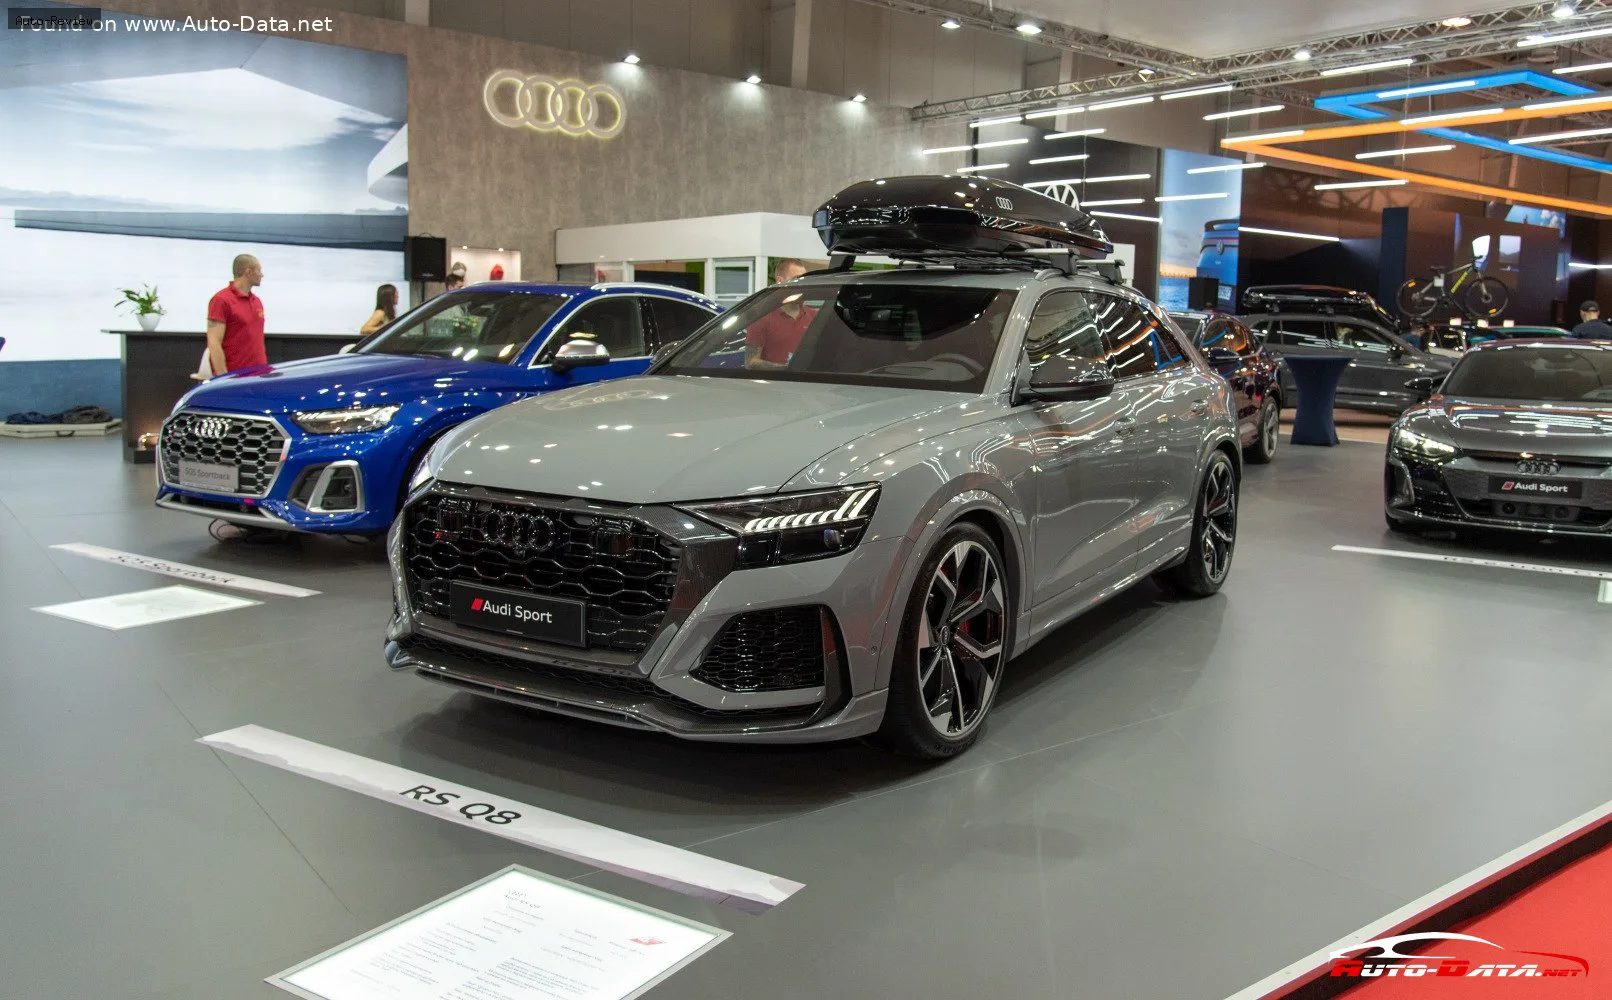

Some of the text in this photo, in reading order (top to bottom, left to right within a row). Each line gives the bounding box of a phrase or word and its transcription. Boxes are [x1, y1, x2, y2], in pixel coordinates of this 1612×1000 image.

[1513, 481, 1569, 494] Audi Sport
[482, 600, 553, 624] Audi Sport
[399, 784, 522, 825] RS Q8
